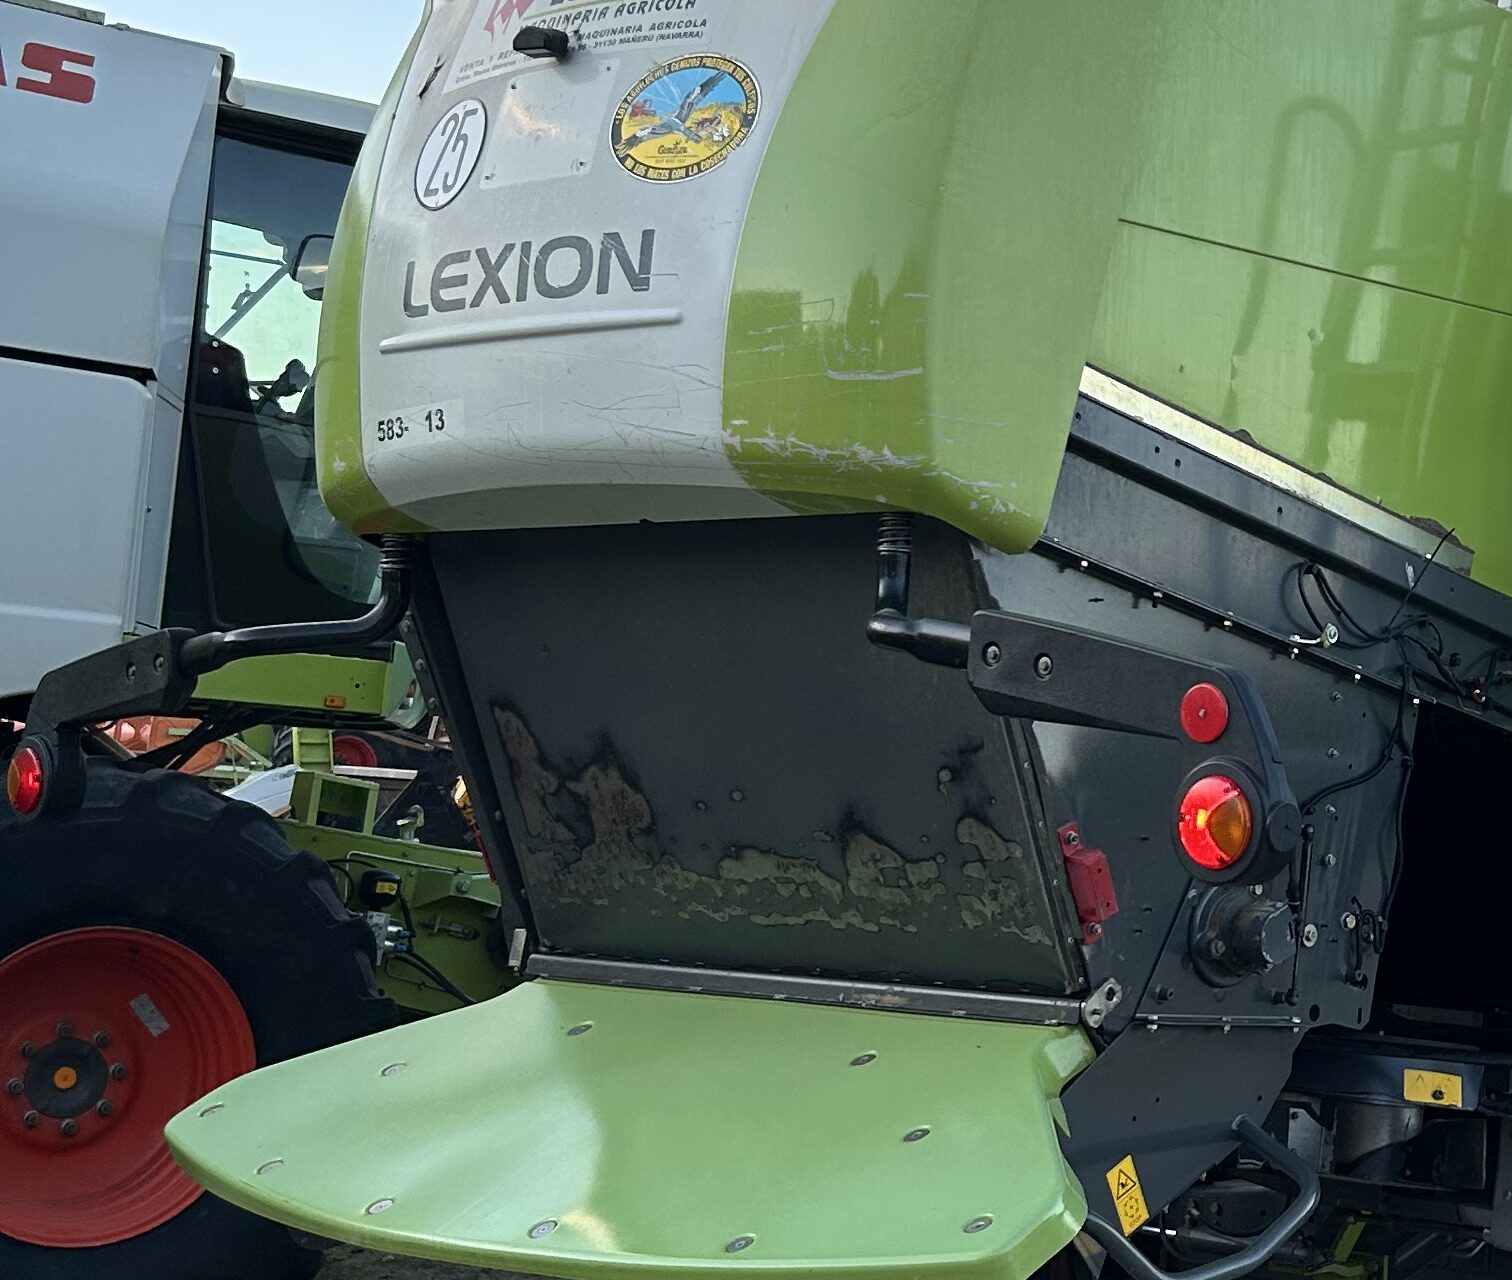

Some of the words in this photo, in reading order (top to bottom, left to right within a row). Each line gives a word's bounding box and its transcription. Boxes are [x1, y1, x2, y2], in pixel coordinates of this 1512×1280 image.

[520, 6, 609, 29] QUINARIA
[649, 19, 707, 32] AGRICOLA
[0, 42, 96, 104] S
[423, 108, 479, 198] 25
[688, 164, 698, 176] LA
[403, 229, 656, 318] LEXION
[425, 408, 445, 432] 13
